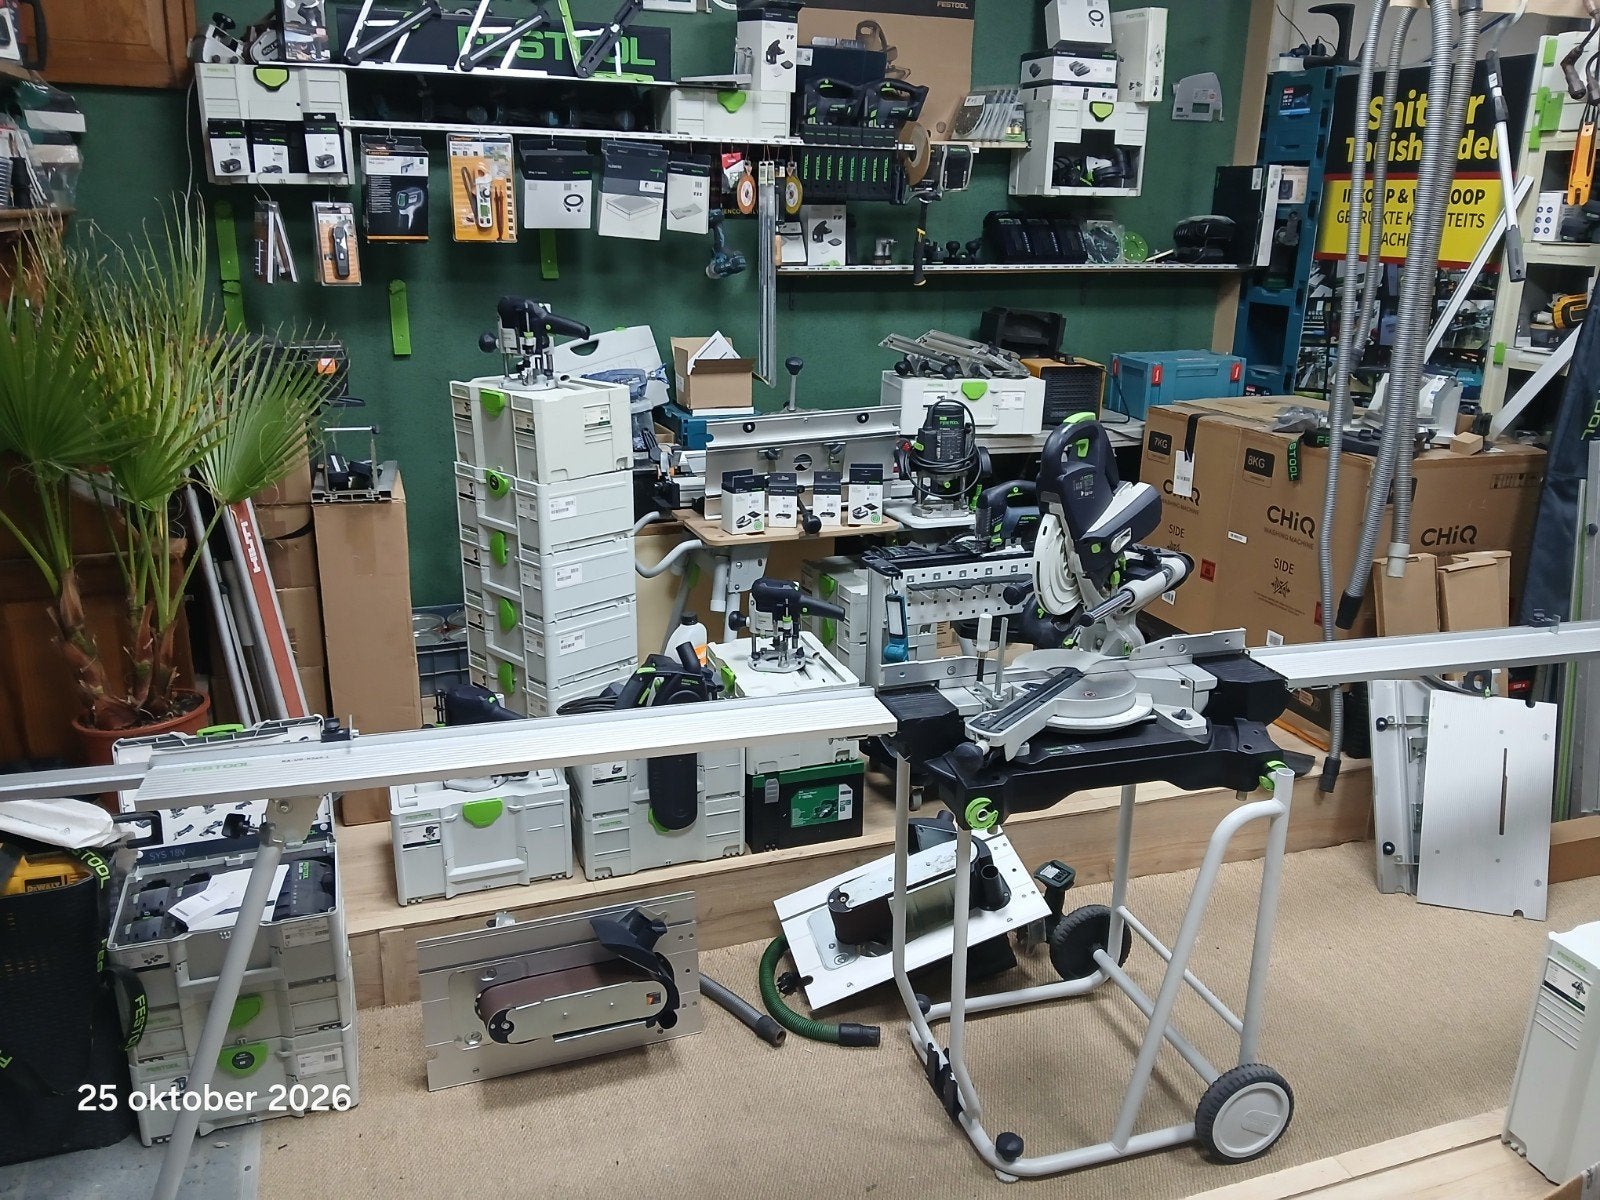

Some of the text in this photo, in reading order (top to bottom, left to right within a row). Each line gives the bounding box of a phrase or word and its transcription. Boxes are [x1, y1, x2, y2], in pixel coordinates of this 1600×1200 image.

[936, 1, 969, 9] FESTOOL
[1367, 89, 1486, 131] Snitr
[1397, 188, 1409, 204] &
[1154, 437, 1169, 450] 7KG
[1247, 454, 1266, 470] 8KG
[1162, 478, 1201, 507] CQ
[1266, 505, 1316, 540] CHiQ
[1168, 523, 1186, 539] SIDE
[1421, 524, 1478, 547] CHiQ
[240, 520, 261, 574] HILTI
[1273, 557, 1295, 575] SIDE
[183, 762, 248, 774] FESTOOL
[149, 847, 186, 861] SYS 18V
